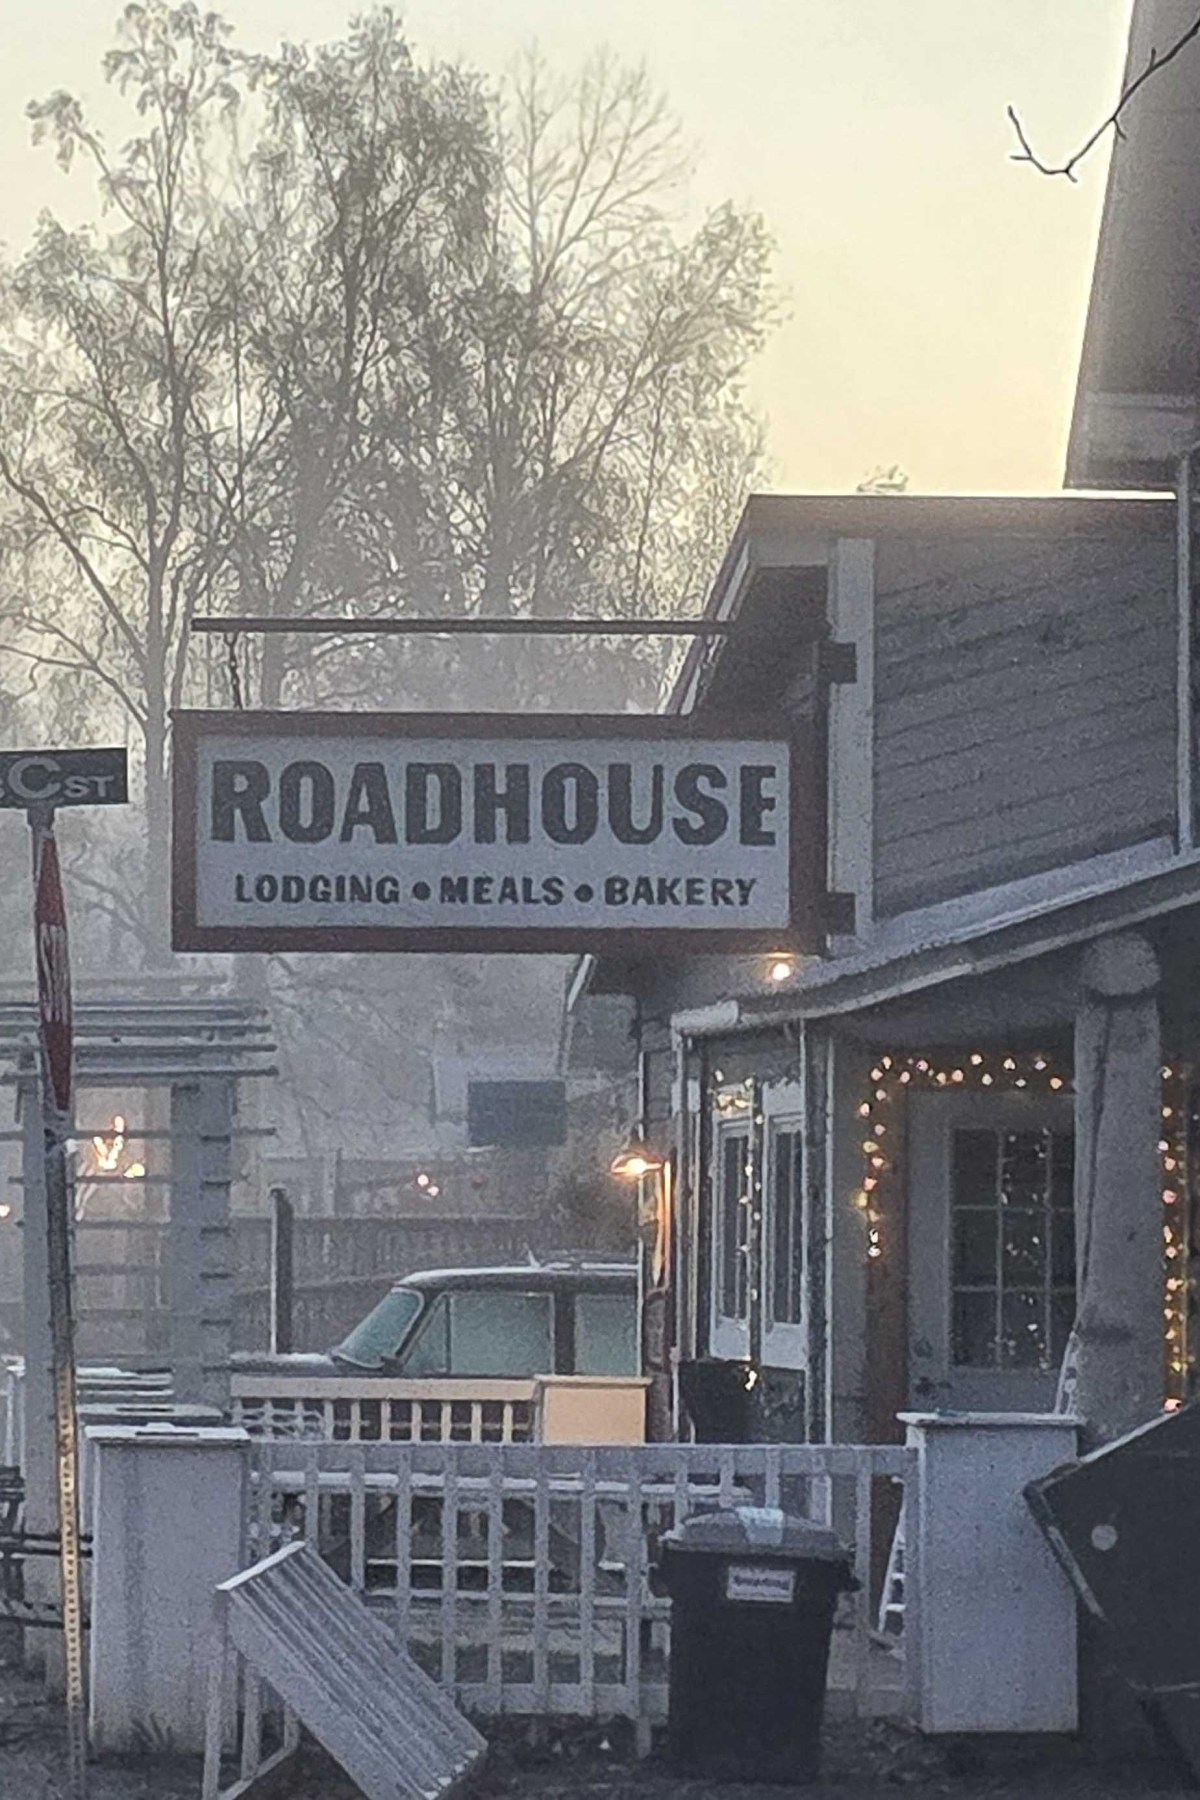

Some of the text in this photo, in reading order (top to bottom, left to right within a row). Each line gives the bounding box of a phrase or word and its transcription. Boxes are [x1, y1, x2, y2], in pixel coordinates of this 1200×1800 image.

[8, 757, 62, 799] C
[64, 775, 115, 798] ST
[210, 760, 777, 846] ROADHOUSE
[235, 873, 757, 907] LODGING MEALS BAKERY
